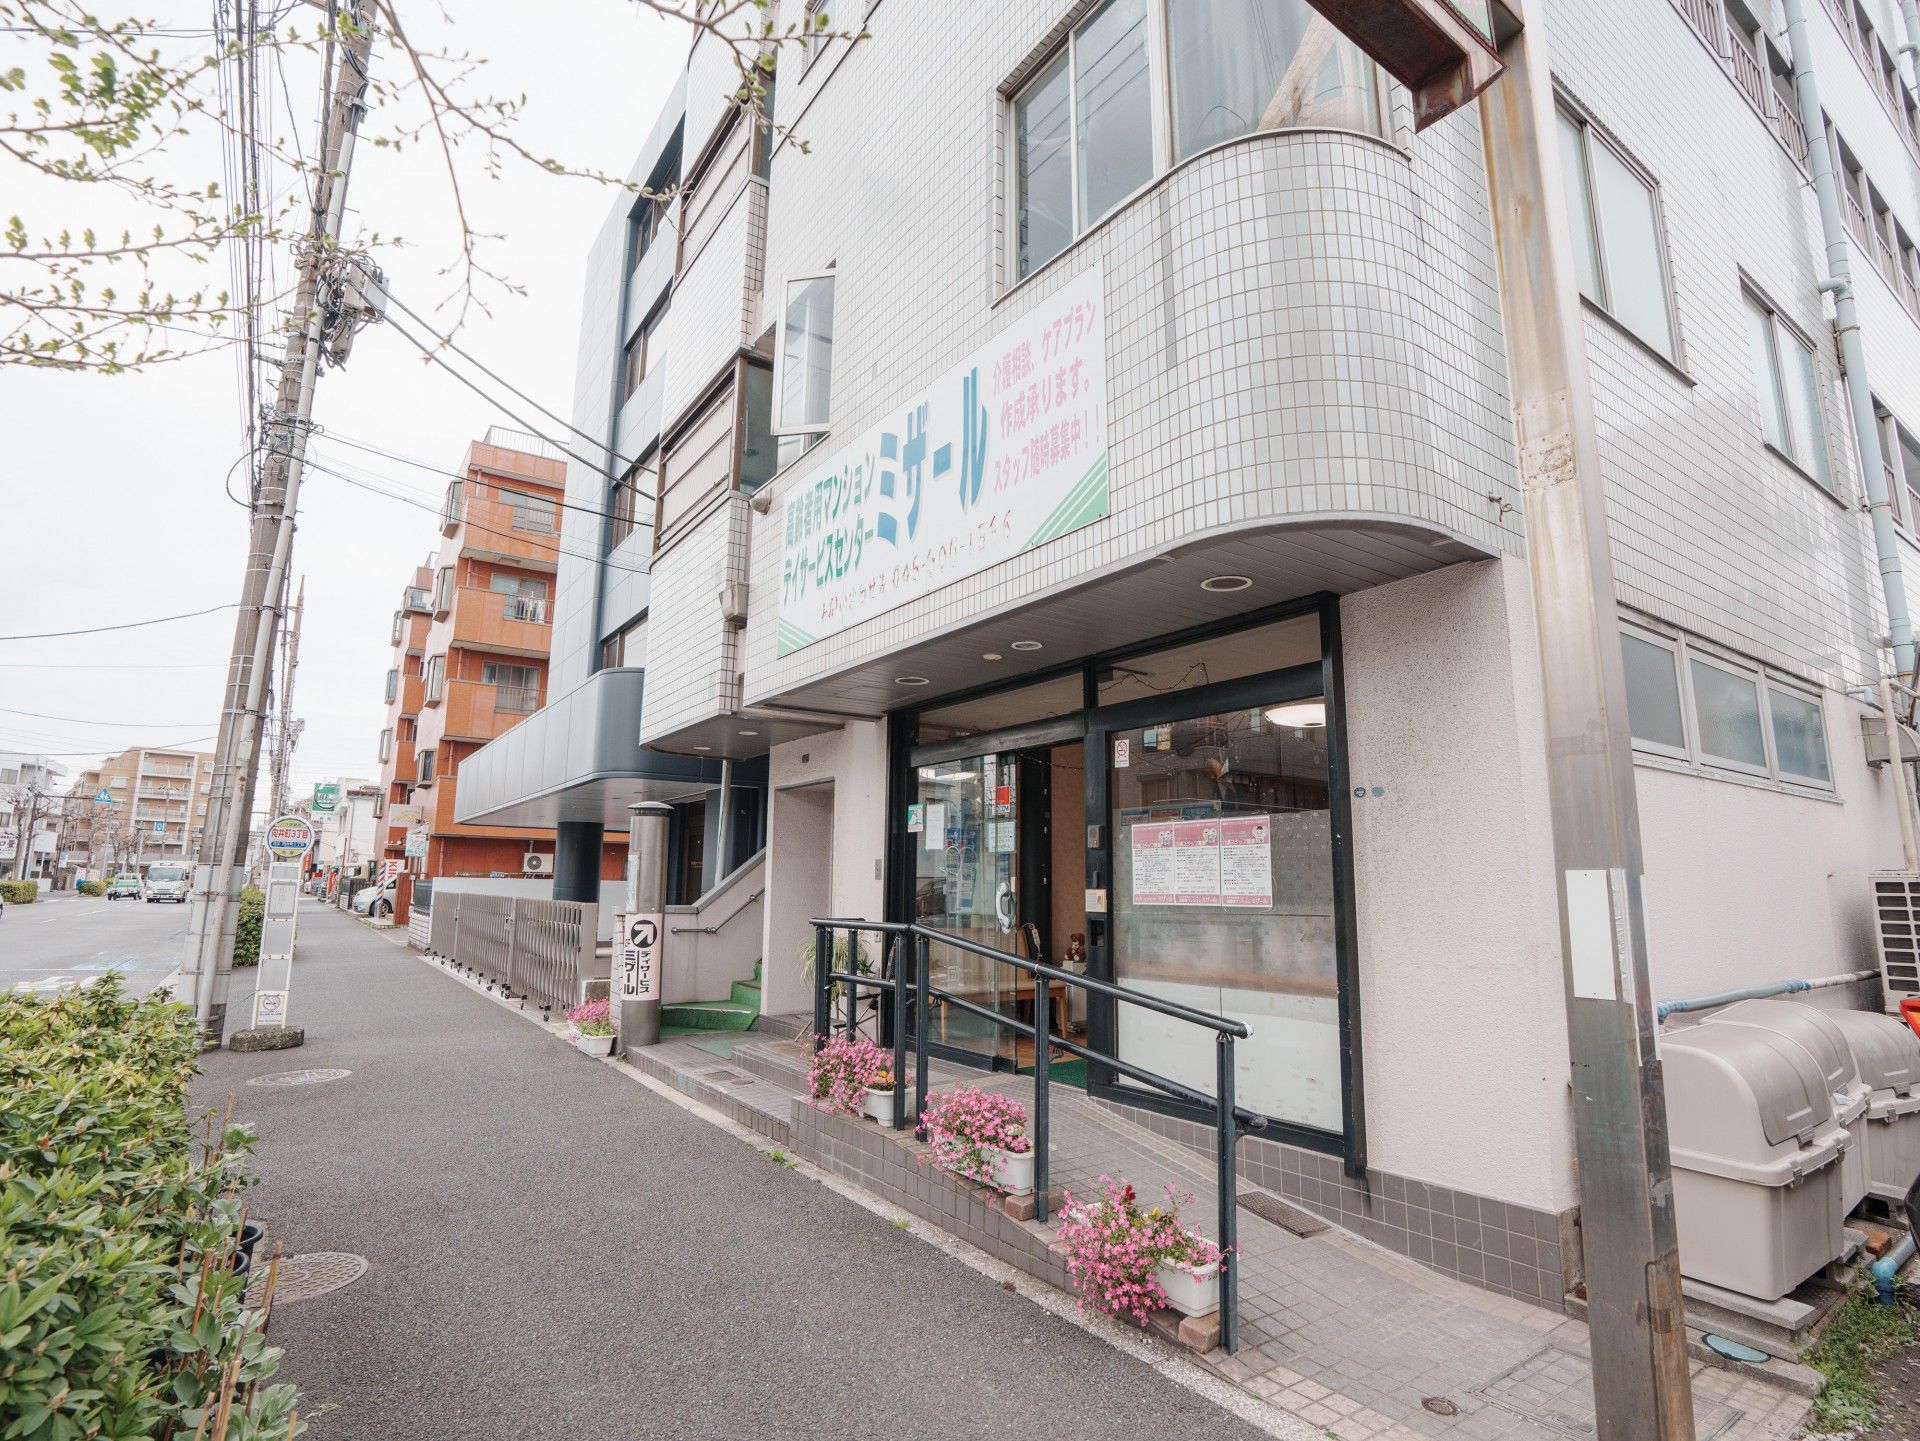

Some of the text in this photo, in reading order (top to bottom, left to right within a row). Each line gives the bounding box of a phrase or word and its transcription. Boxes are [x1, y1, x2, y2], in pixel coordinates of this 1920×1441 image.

[1001, 356, 1089, 440] 作成承ります。
[877, 367, 987, 546] ミザール
[785, 451, 875, 550] 高齢者用マンション
[271, 828, 309, 839] 向井町3丁目
[623, 950, 636, 995] ミザール
